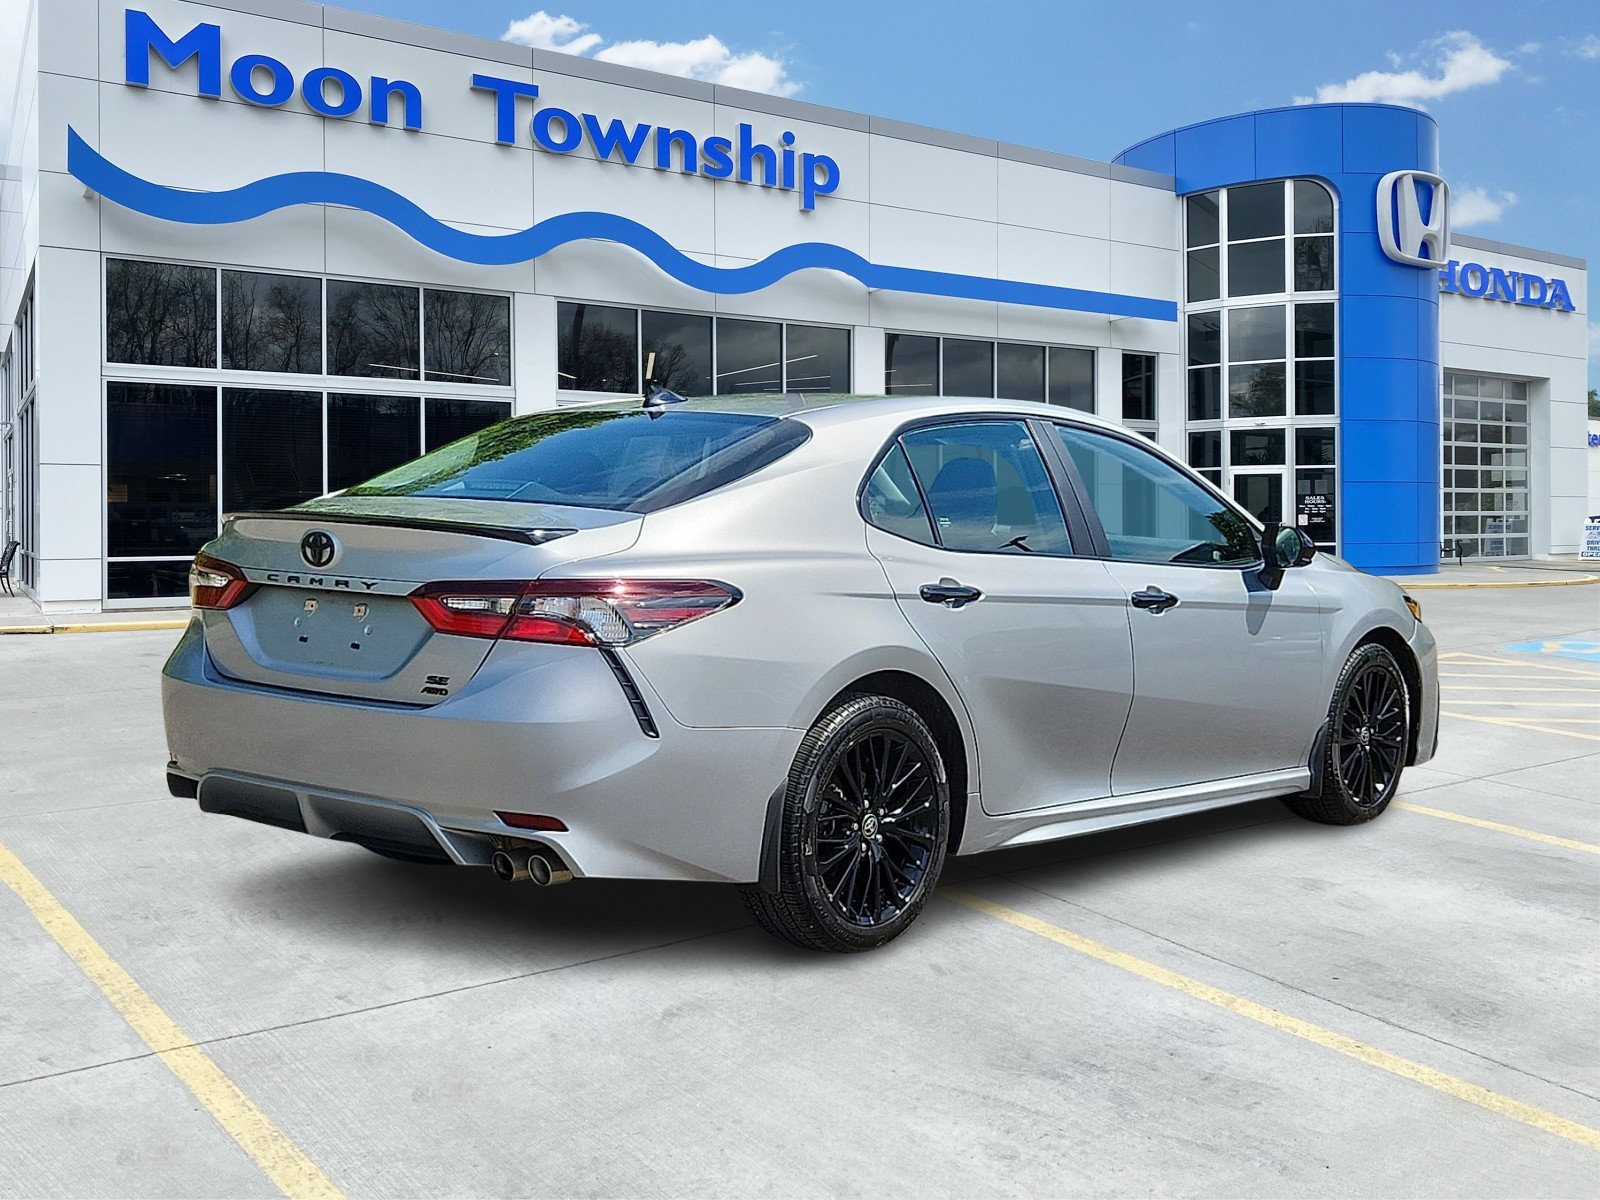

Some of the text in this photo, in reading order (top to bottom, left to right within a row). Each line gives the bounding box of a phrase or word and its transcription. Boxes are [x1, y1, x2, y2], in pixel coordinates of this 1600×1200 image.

[125, 9, 840, 212] Moon Township
[1439, 260, 1576, 312] HONDA
[266, 573, 379, 590] CAMRY
[425, 675, 450, 686] SE
[420, 686, 449, 696] AWD
